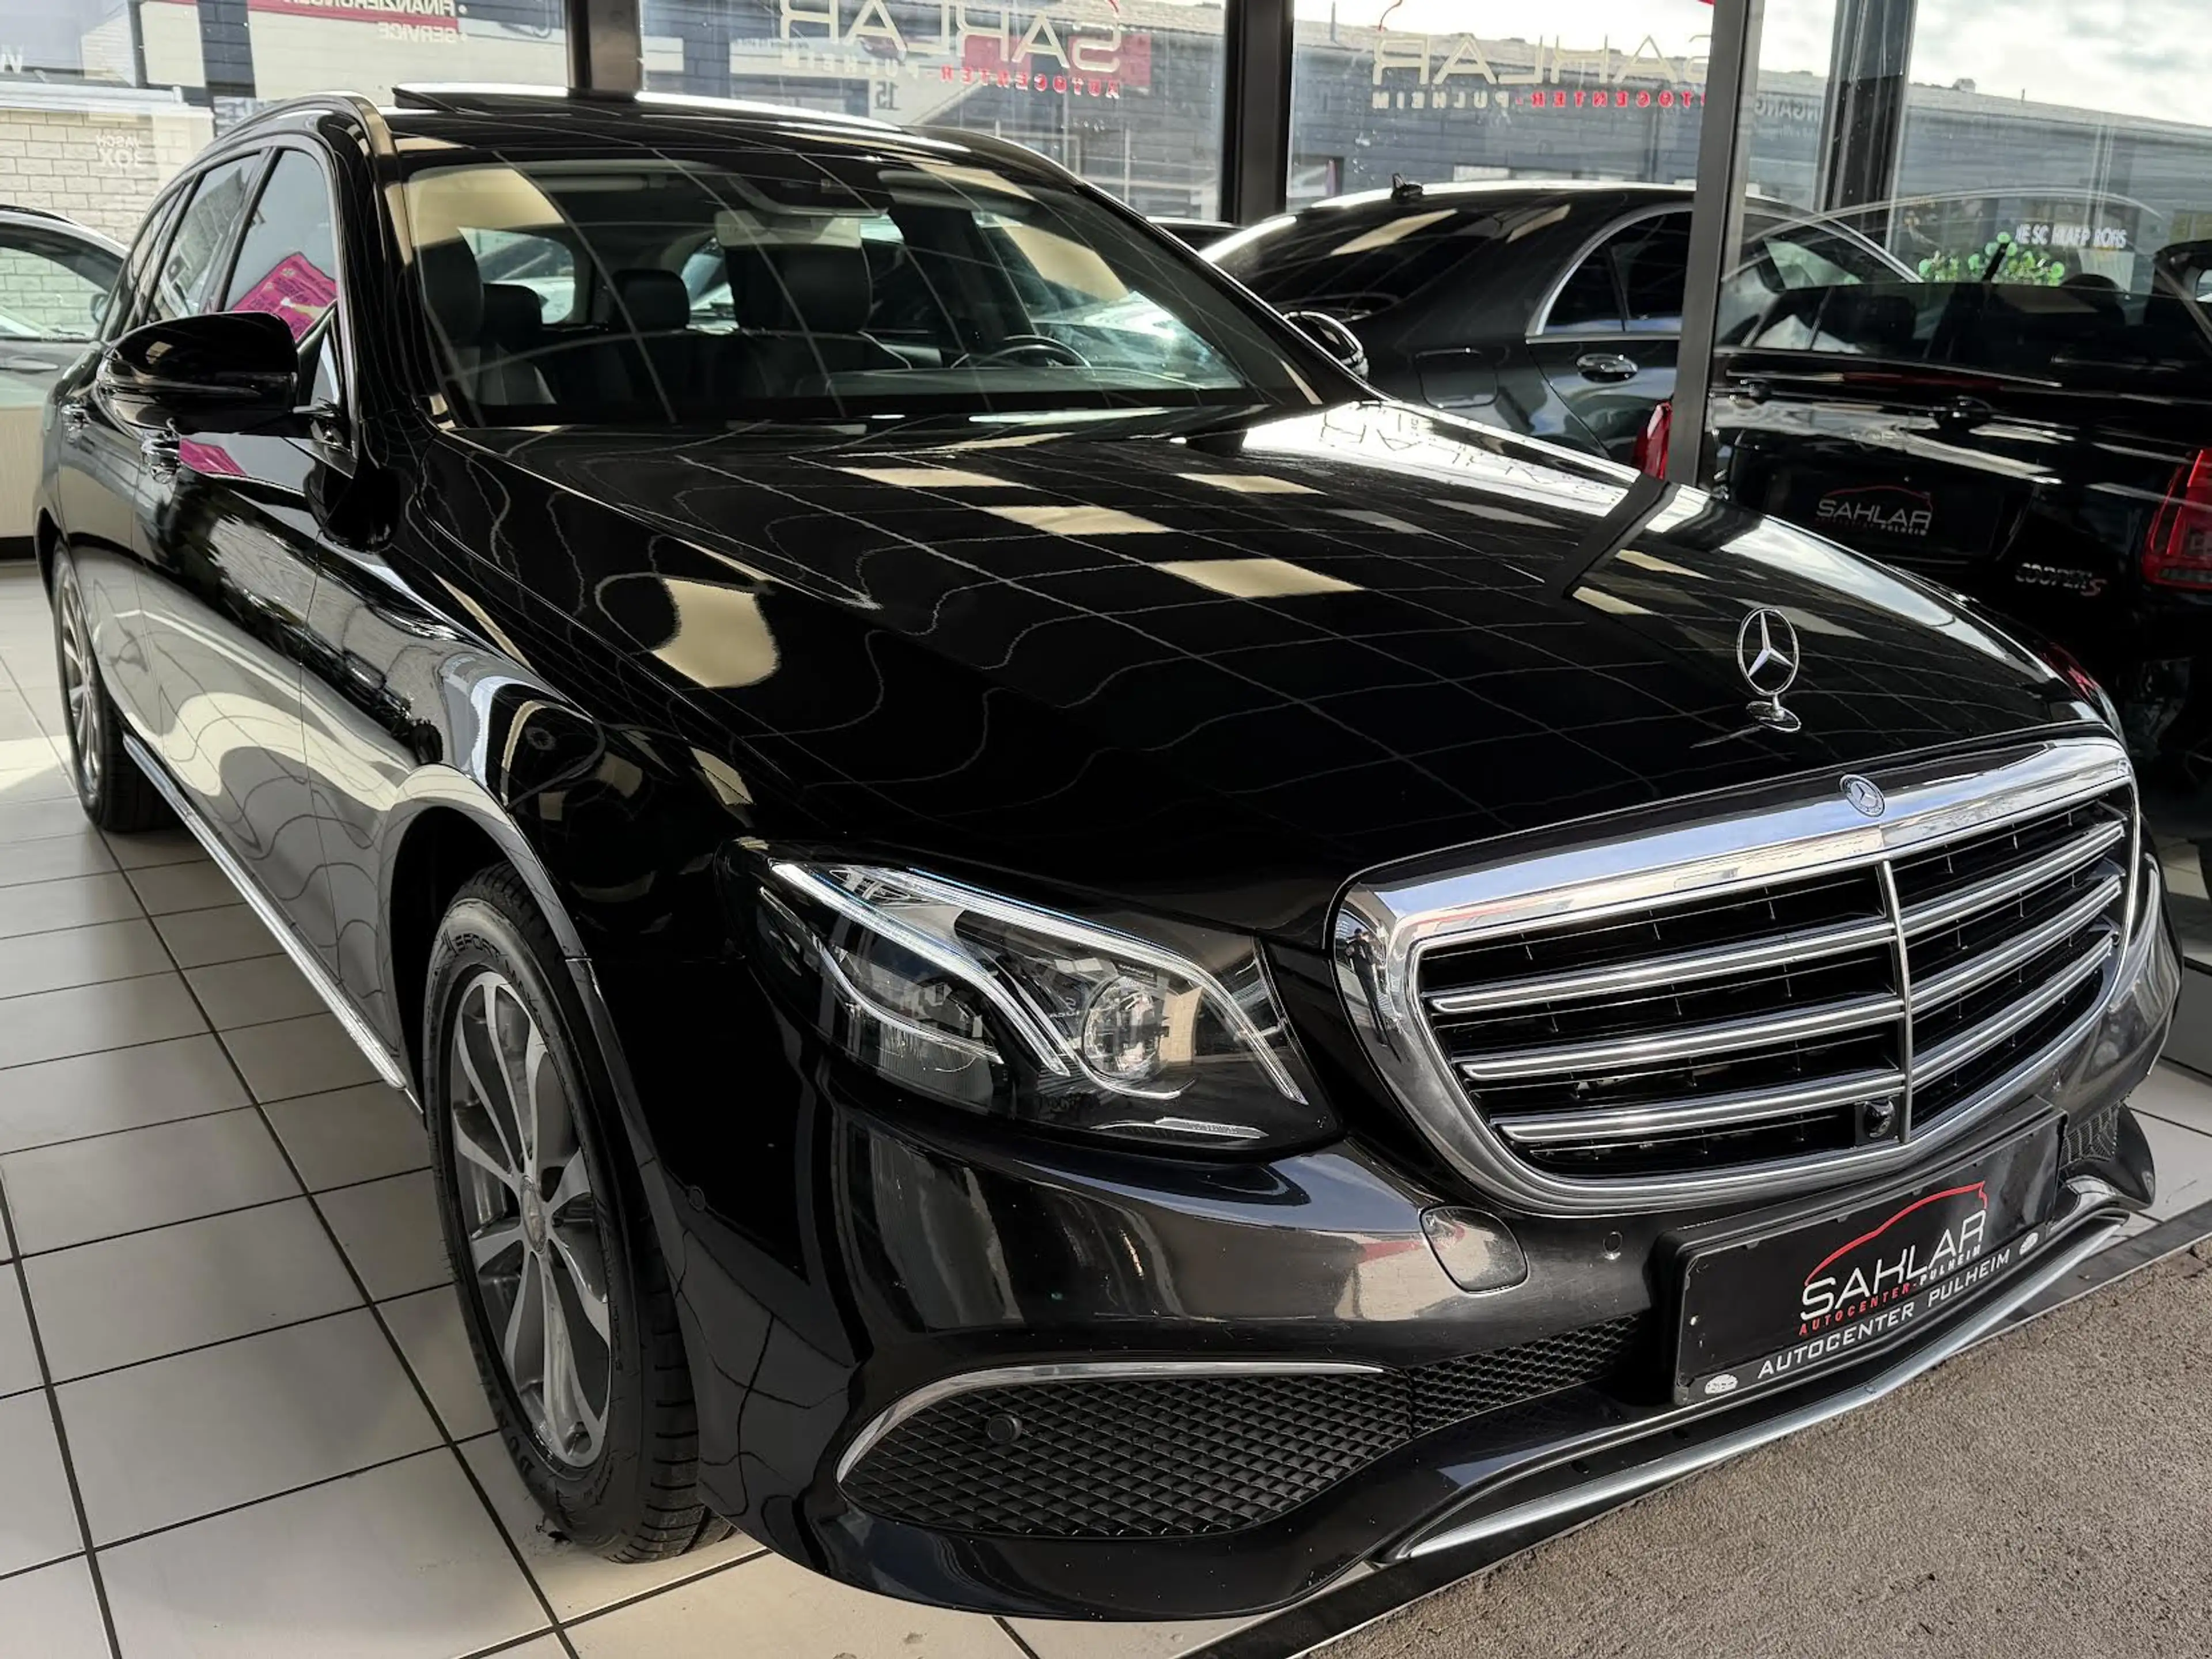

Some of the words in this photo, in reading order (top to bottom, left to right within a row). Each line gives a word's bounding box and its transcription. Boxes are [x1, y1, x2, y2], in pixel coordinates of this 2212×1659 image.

[1816, 498, 1931, 529] SAHLAR
[1757, 1302, 1915, 1380] AUTOCENTER
[1927, 1248, 2011, 1308] PULHEIM
[1800, 1209, 1986, 1320] SAHLAR
